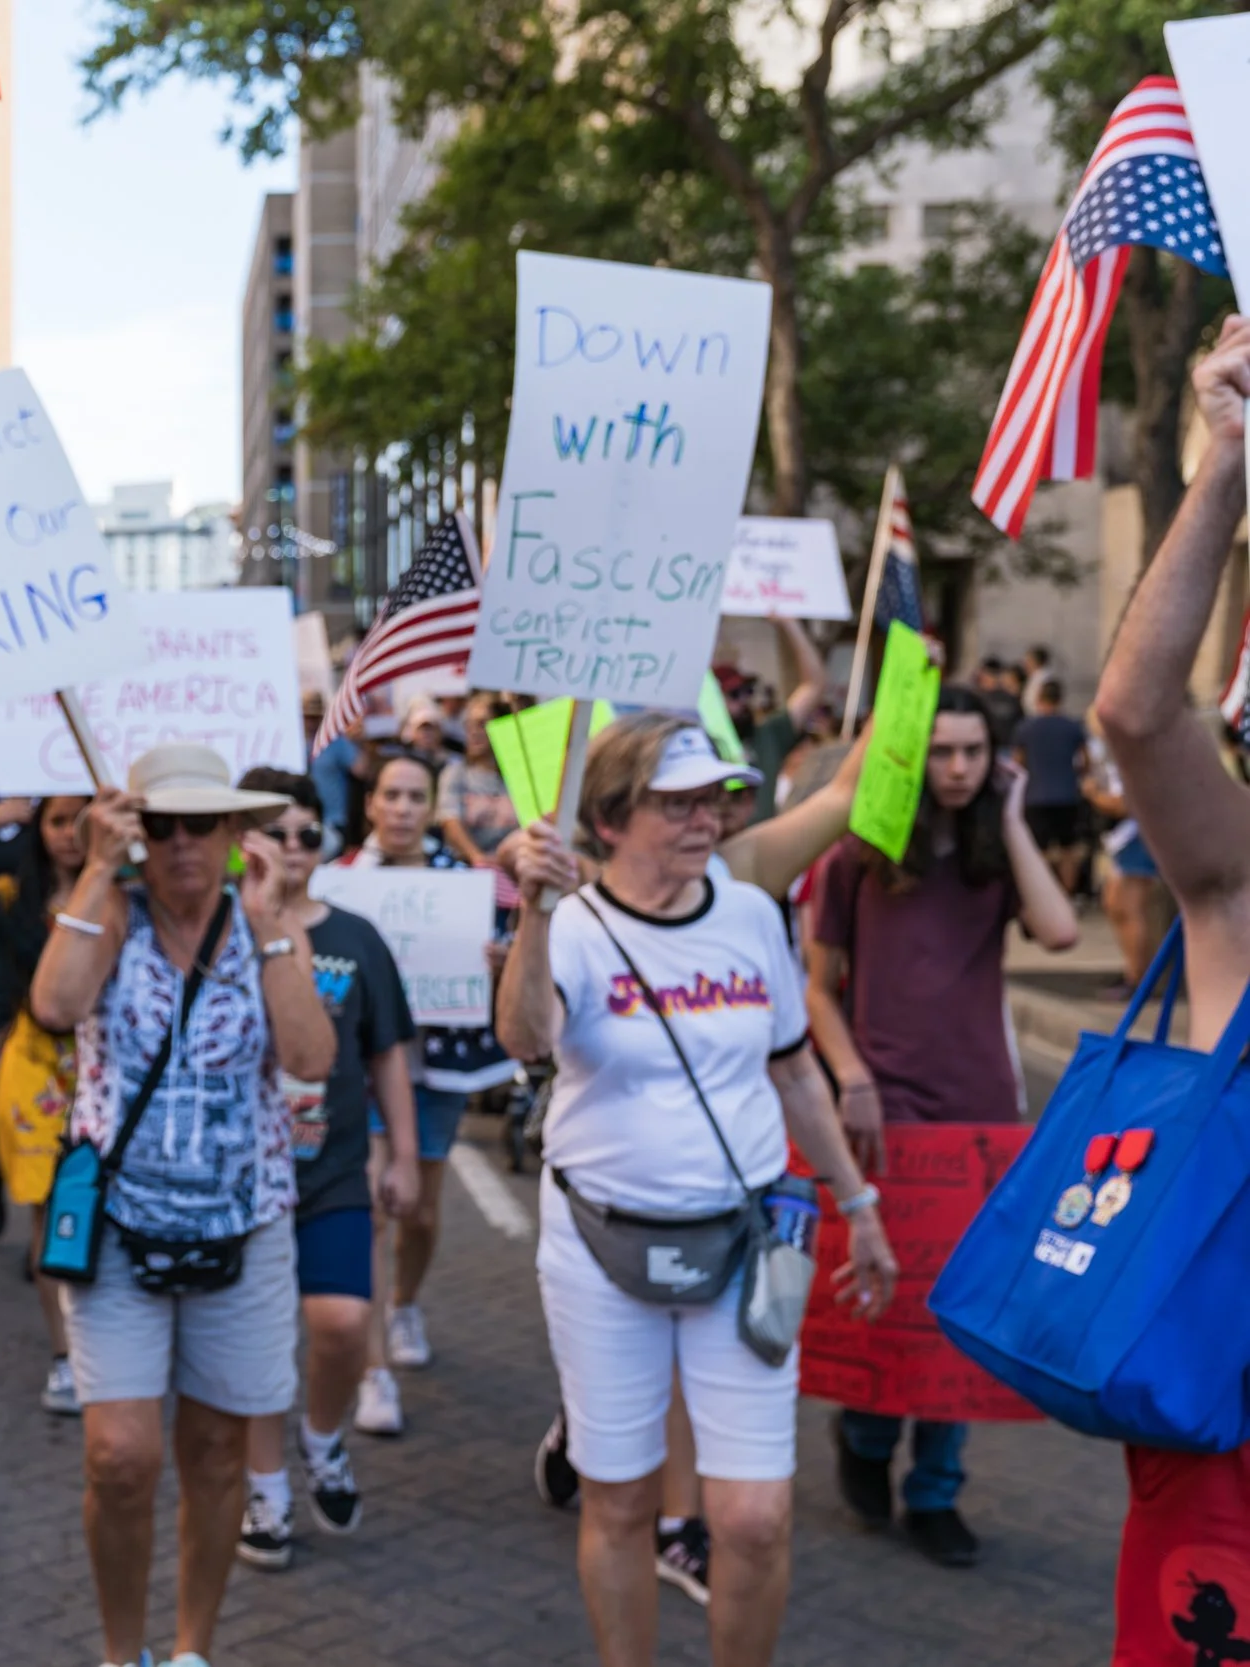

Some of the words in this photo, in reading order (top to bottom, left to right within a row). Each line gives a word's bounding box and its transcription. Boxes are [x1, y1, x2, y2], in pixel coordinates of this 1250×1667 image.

[535, 305, 731, 377] Down
[553, 401, 686, 468] with
[506, 490, 725, 613] Fascism
[116, 673, 279, 720] AMERICA
